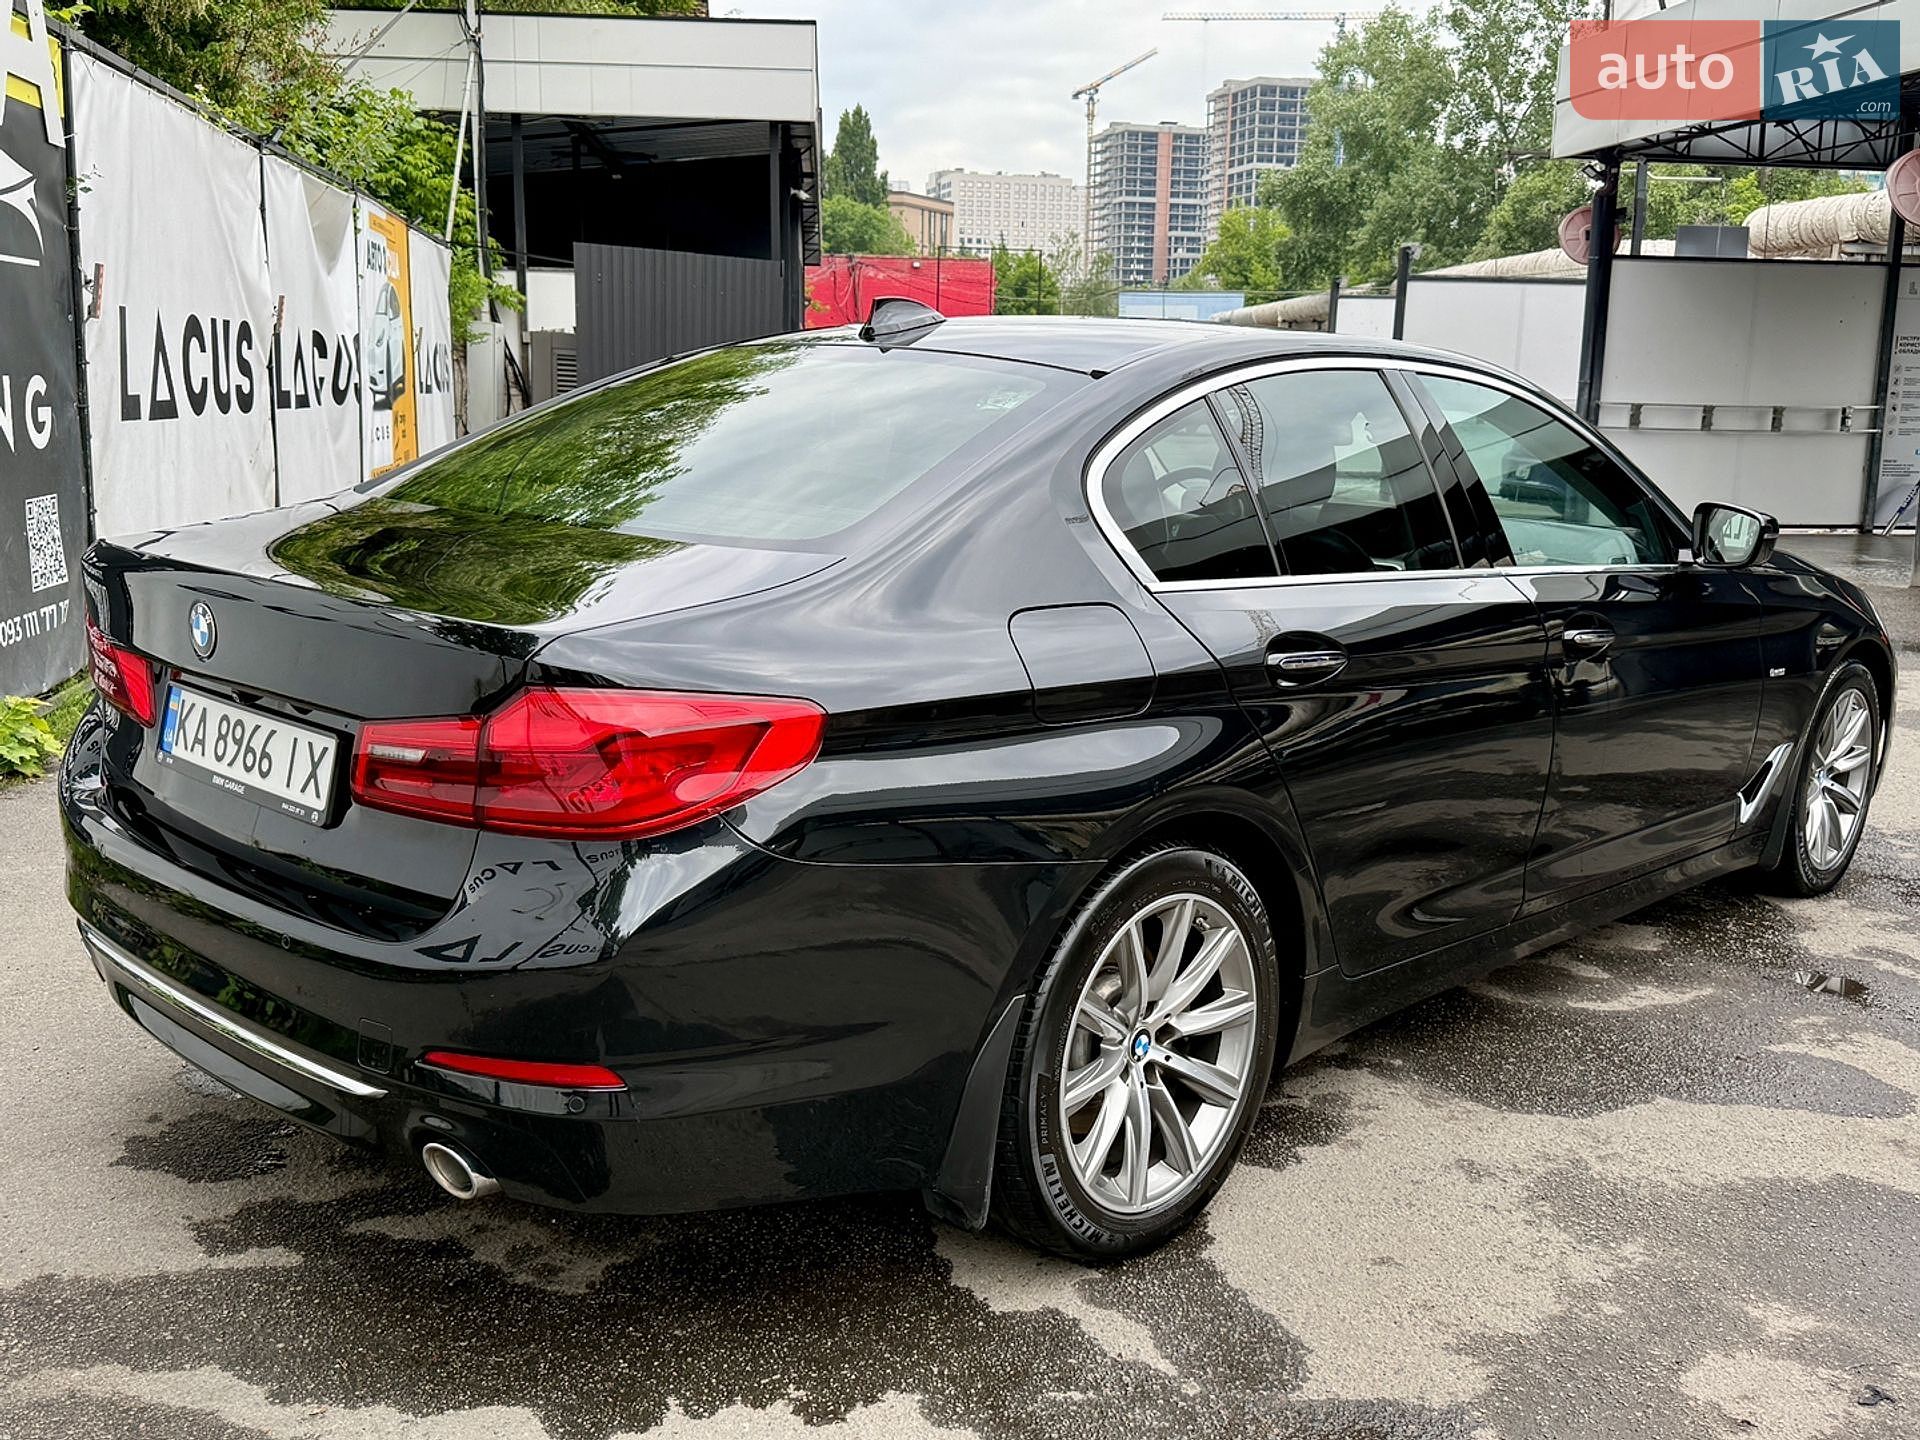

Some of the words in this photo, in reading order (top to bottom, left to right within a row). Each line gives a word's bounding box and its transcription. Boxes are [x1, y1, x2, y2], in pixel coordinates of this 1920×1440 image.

[119, 305, 255, 421] LACUS
[0, 617, 23, 648] 093
[23, 610, 41, 638] 111
[40, 604, 58, 632] 77
[175, 699, 207, 757] KA
[214, 713, 278, 779] 8966
[286, 737, 329, 799] IX
[1041, 1092, 1050, 1145] PRIMACY
[1043, 1160, 1105, 1245] MICHELIN
